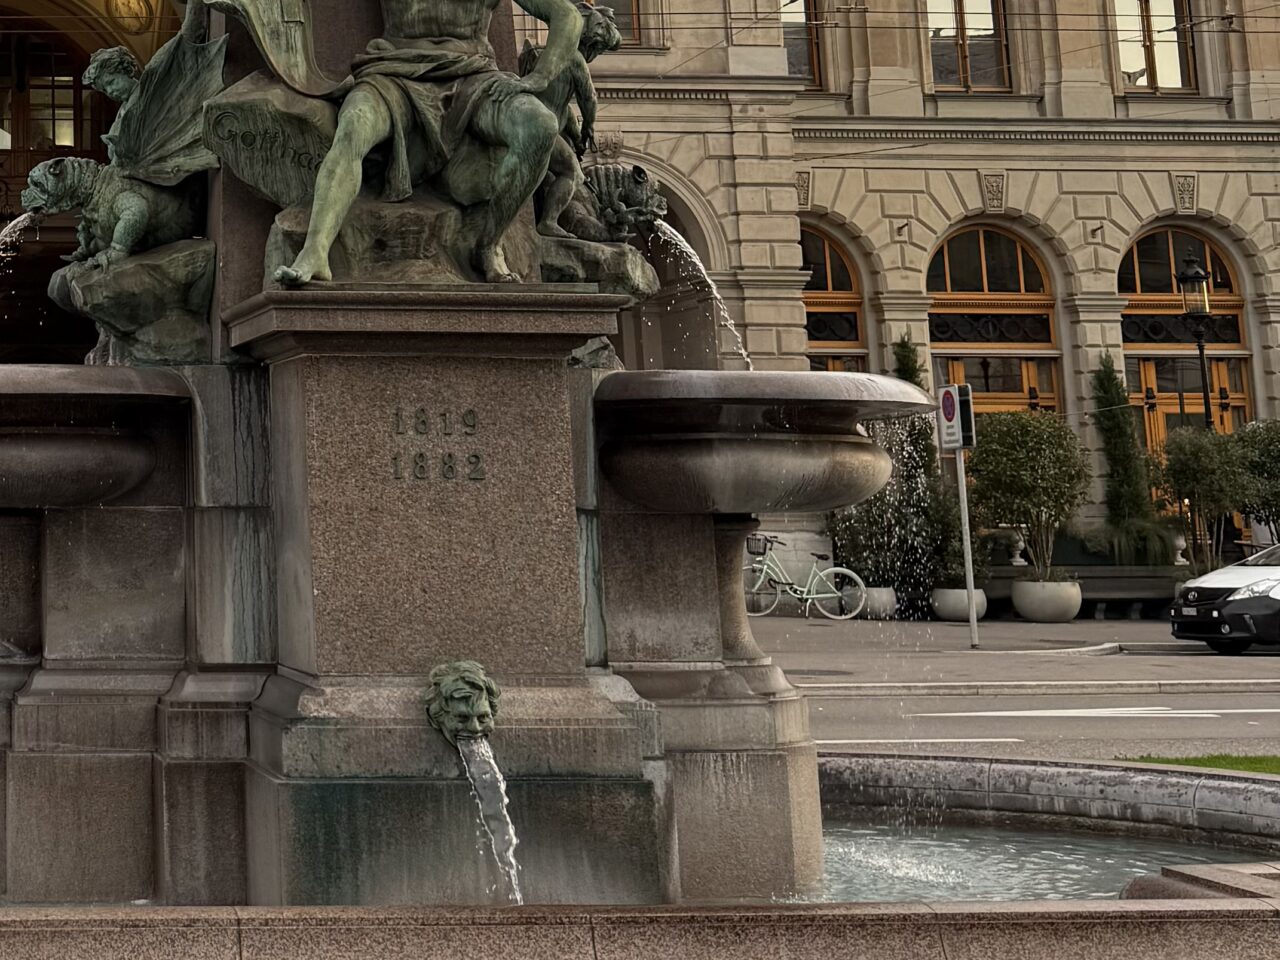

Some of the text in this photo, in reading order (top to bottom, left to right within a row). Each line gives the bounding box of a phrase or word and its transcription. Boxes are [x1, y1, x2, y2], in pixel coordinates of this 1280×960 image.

[211, 110, 322, 173] Gottha
[391, 407, 480, 436] 1819
[391, 451, 487, 481] 1882
